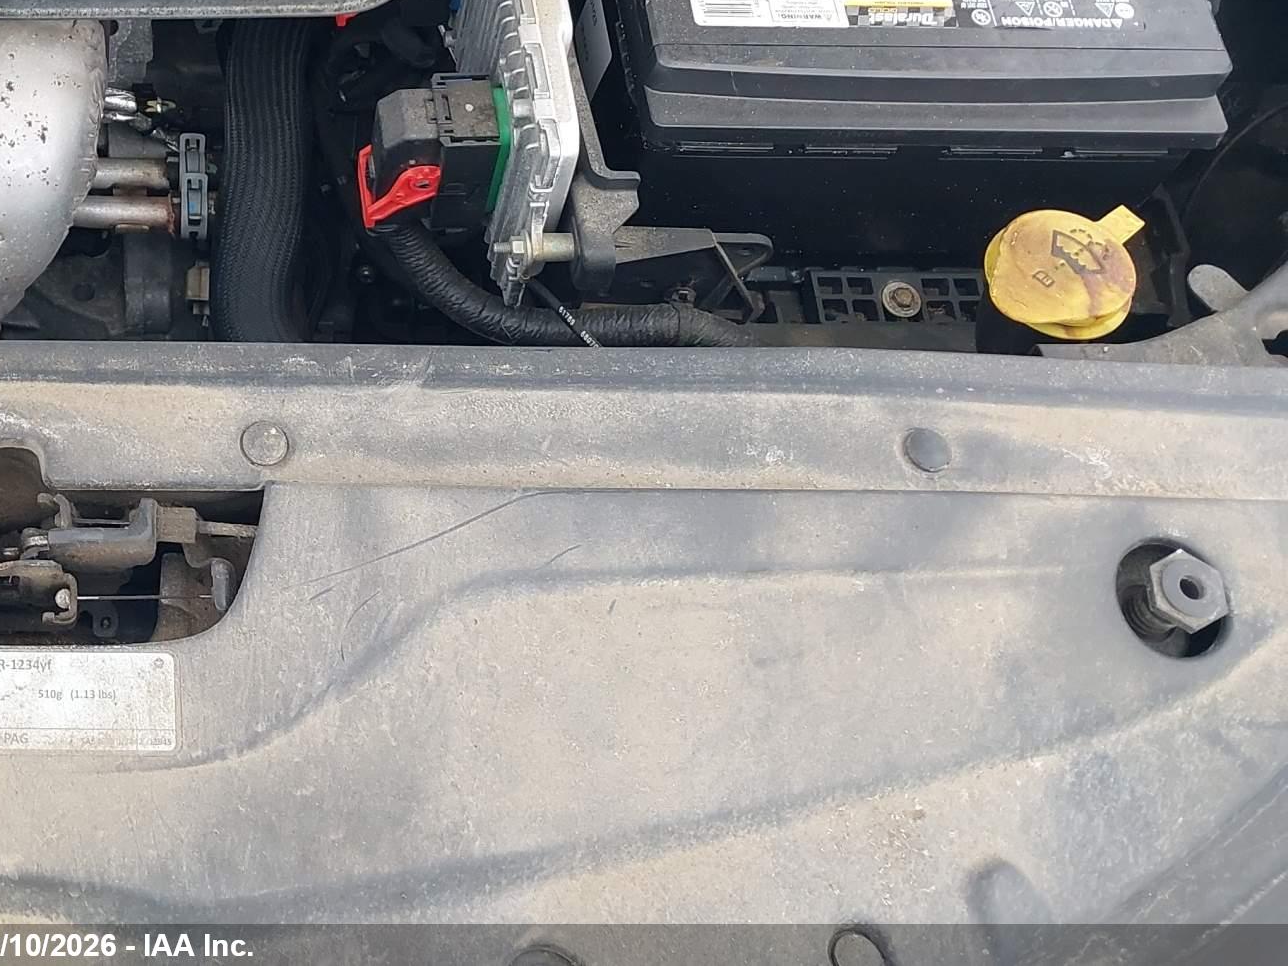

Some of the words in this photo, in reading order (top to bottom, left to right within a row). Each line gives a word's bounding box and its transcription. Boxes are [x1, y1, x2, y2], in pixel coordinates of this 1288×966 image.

[868, 12, 938, 26] Duralast
[38, 689, 63, 702] 510g
[70, 689, 95, 703] (1.13
[97, 689, 117, 703] lbs)
[3, 732, 29, 745] PAG
